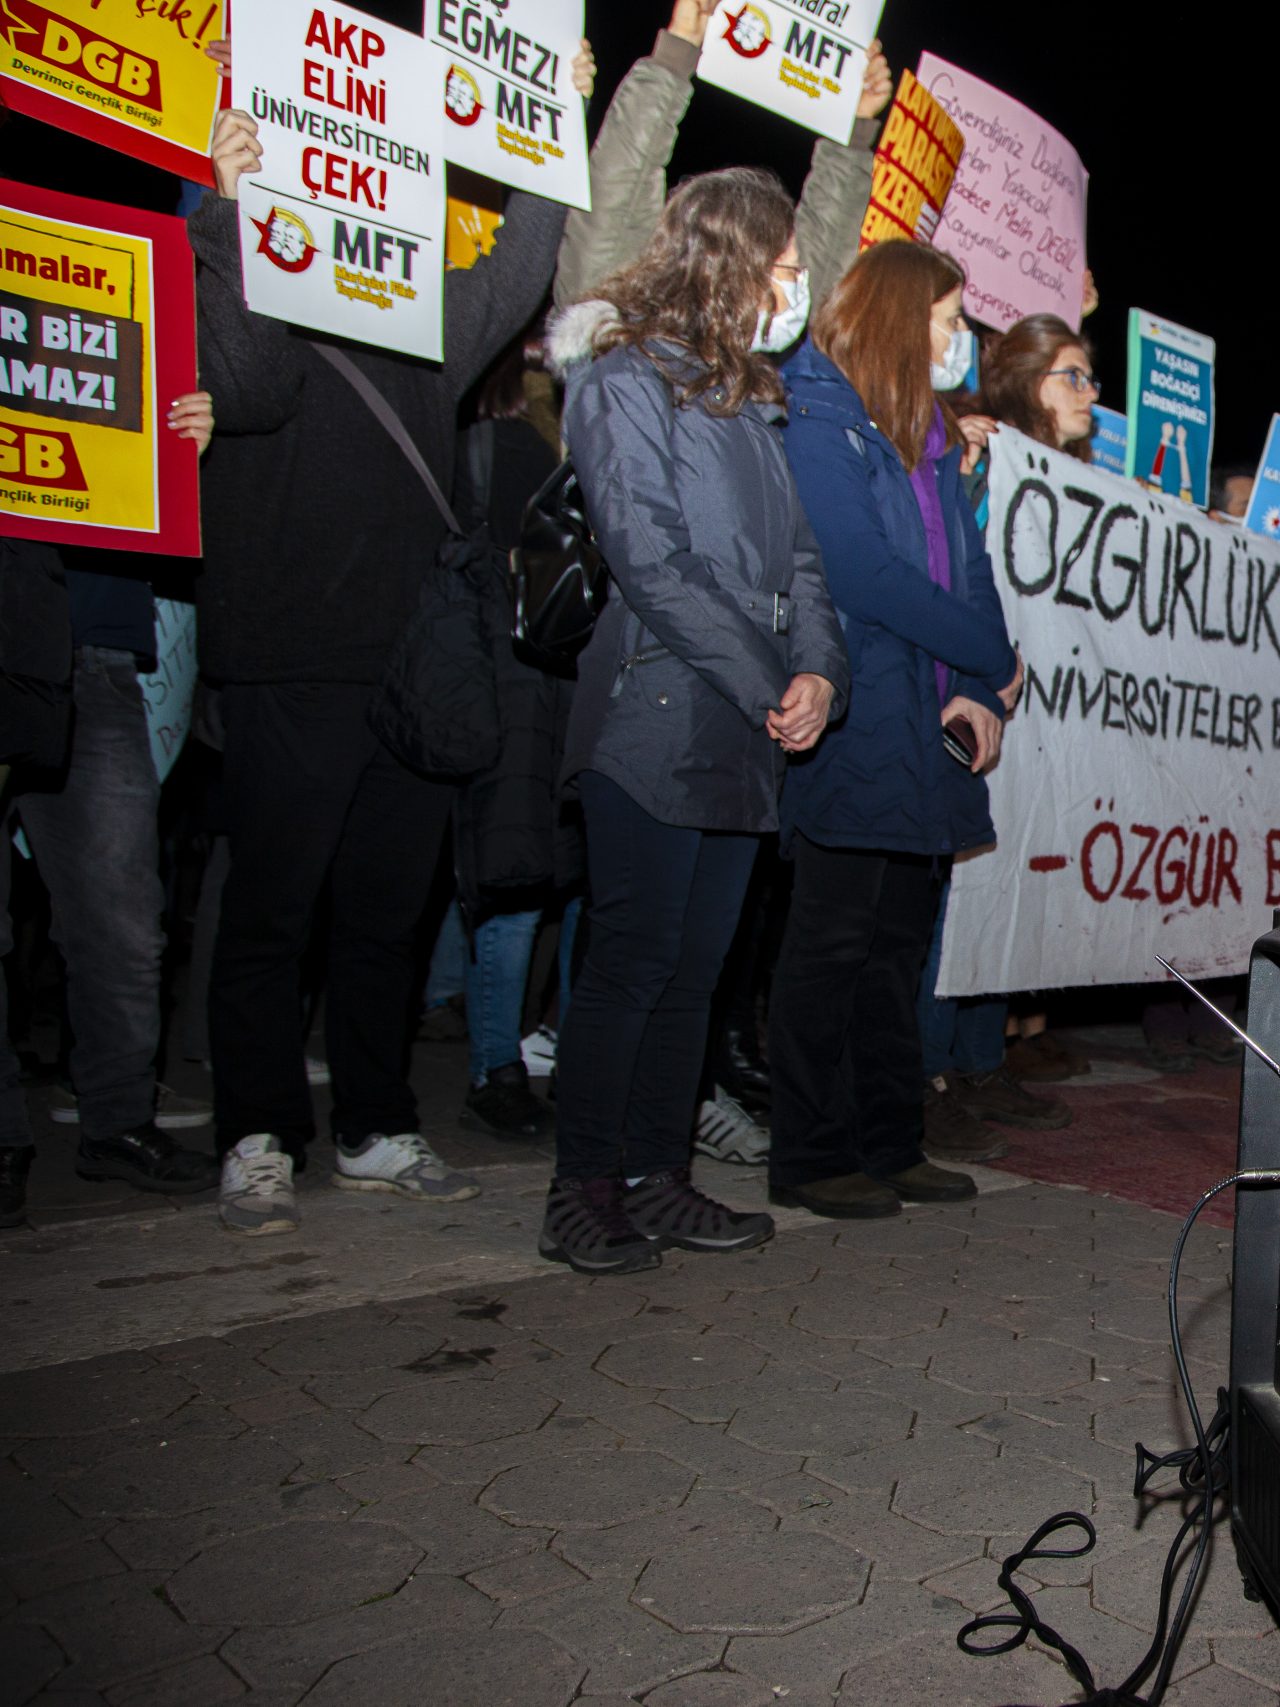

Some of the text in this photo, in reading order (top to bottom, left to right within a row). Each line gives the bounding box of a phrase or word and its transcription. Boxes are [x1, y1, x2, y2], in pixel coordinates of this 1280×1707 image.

[41, 18, 152, 97] DGB
[304, 8, 386, 70] AKP
[783, 19, 853, 79] MFT
[11, 57, 163, 127] Devrimci Gençlik Birliği
[303, 58, 387, 126] ELİNİ
[496, 79, 563, 143] MFT
[251, 86, 431, 177] ÜNİVERSİTEDEN
[301, 146, 388, 212] ÇEK!
[332, 218, 419, 281] MFT
[42, 313, 117, 360] BİZİ
[1150, 369, 1201, 402] BOĞAZİÇİ
[41, 493, 90, 511] Birliği
[1024, 645, 1264, 754] NİVERSİTELER
[1080, 797, 1242, 908] ÖZGÜR
